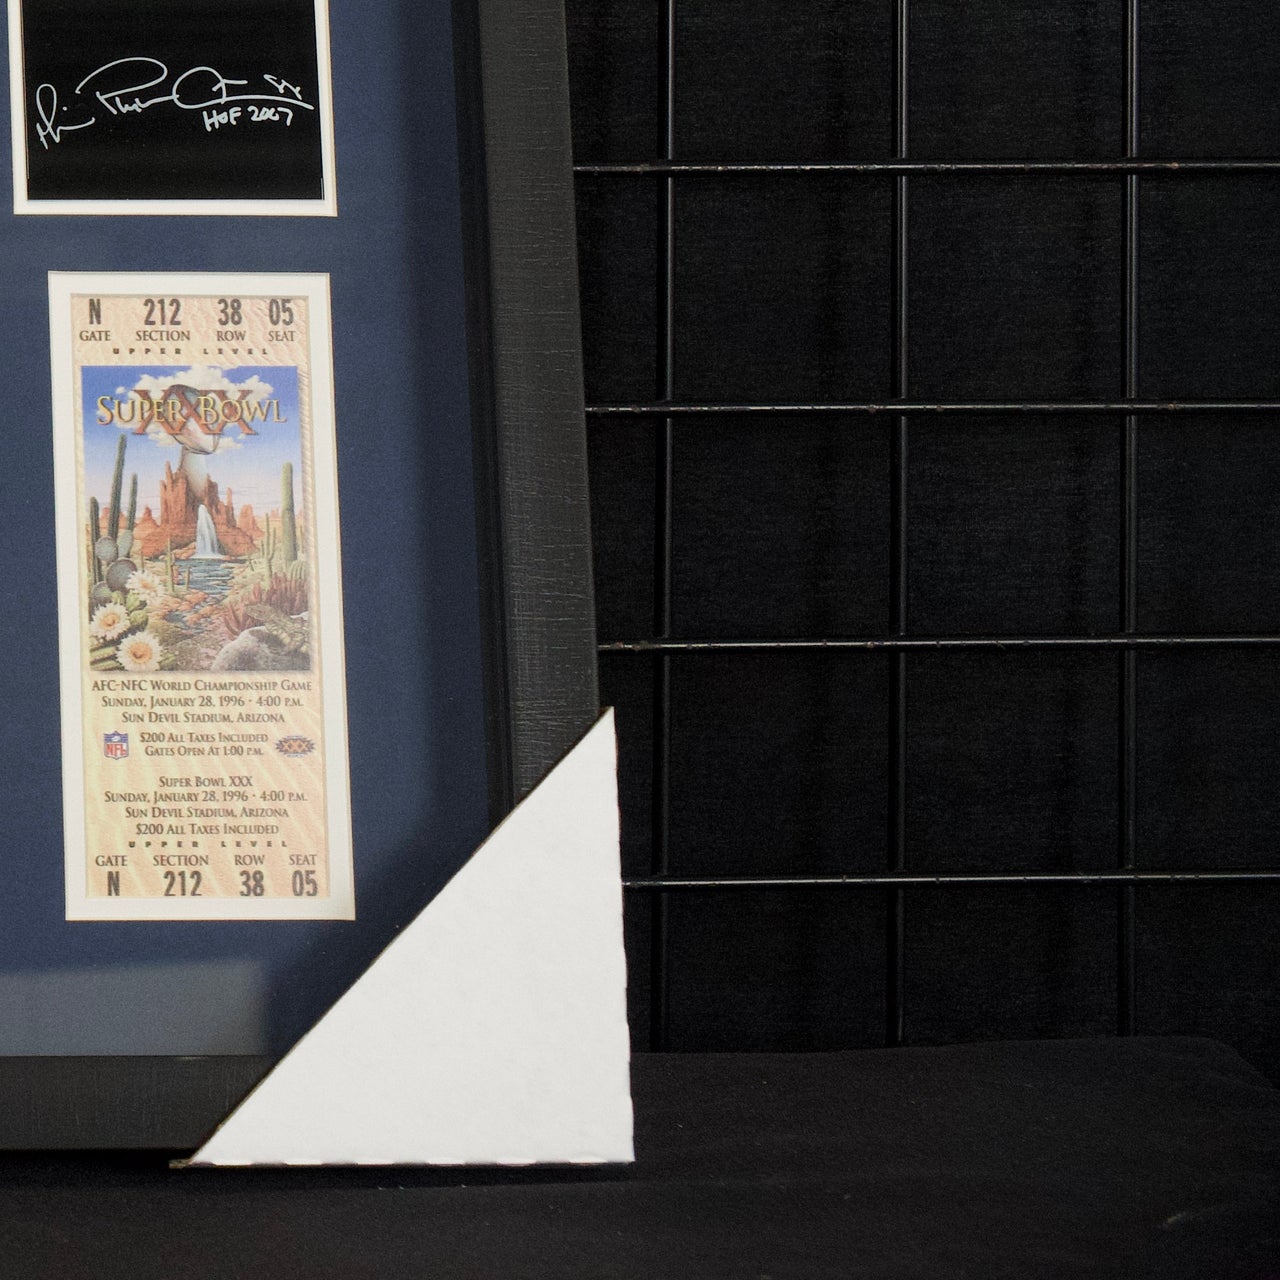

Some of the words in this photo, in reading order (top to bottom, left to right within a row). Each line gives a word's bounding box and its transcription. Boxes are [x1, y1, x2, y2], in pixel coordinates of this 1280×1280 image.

[90, 299, 101, 324] N
[144, 299, 181, 325] 212
[218, 299, 242, 326] 38
[269, 299, 294, 326] 05
[80, 331, 111, 341] GATE
[136, 331, 190, 341] SECTION
[217, 331, 246, 341] ROW
[268, 331, 296, 341] SEAT
[96, 396, 183, 425] SUPER
[197, 397, 288, 424] BOWL
[92, 680, 147, 691] AFC-NFC
[150, 680, 191, 691] WORLD
[194, 680, 277, 691] CHAMPIONSHIP
[280, 681, 312, 691] GAME
[102, 696, 147, 708] SUNDAY,
[150, 696, 196, 709] JANUARY
[219, 696, 245, 706] 1996
[256, 696, 280, 706] 4:00
[106, 744, 127, 756] NFL
[107, 871, 120, 896] N
[164, 871, 203, 896] 212
[240, 871, 264, 896] 38
[292, 870, 318, 896] 05
